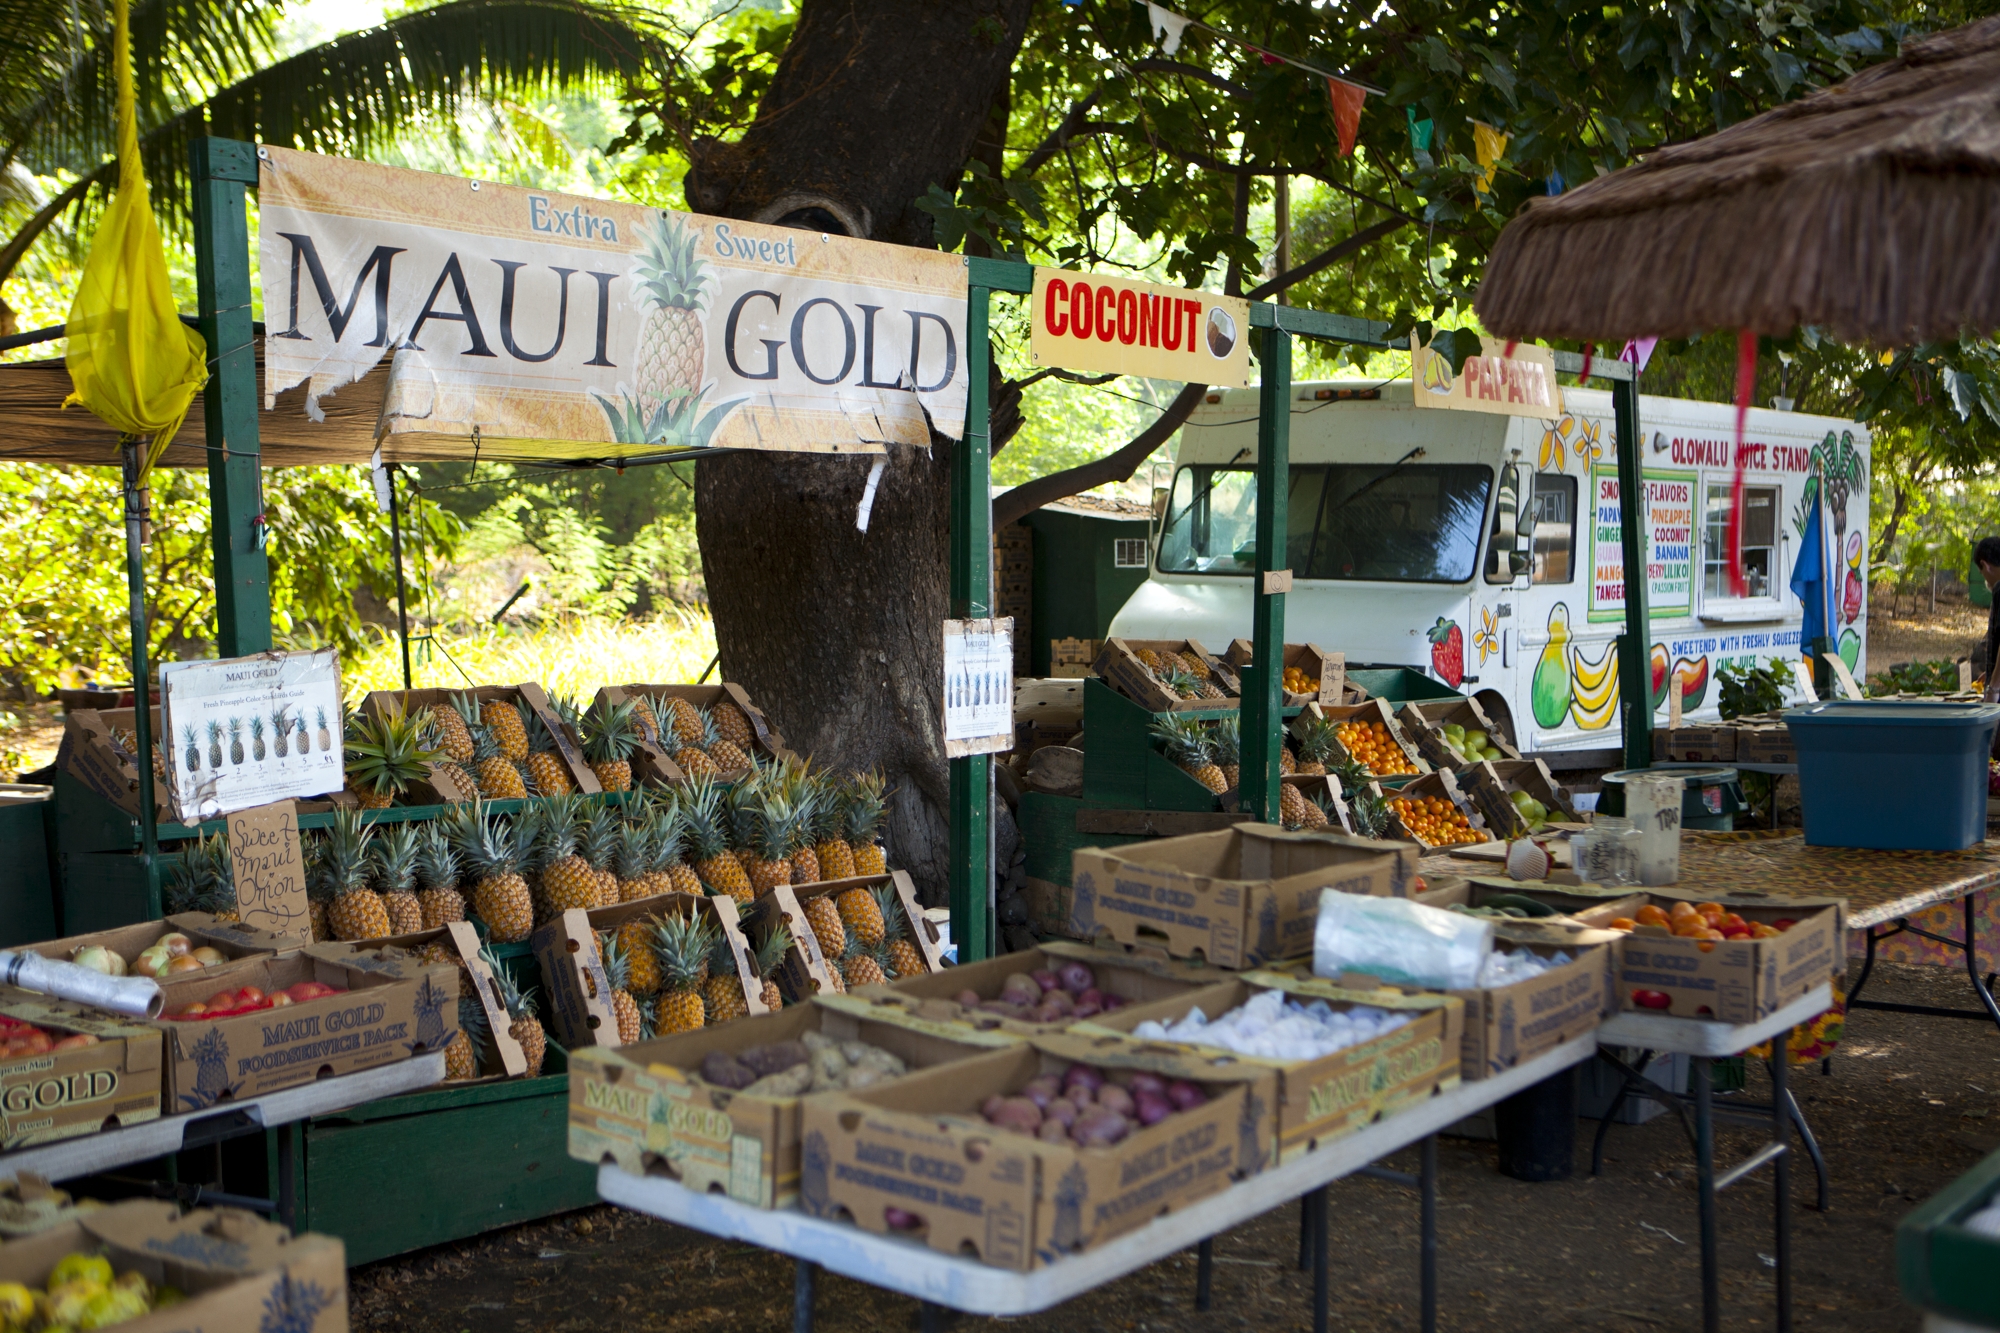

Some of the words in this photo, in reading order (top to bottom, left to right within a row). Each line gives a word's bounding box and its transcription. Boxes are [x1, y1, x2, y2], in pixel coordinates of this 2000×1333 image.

[529, 196, 618, 242] Extra
[714, 225, 796, 266] Sweet
[276, 232, 621, 368] MAUI
[725, 289, 957, 392] GOLD
[1045, 279, 1202, 353] COCONUT
[1464, 355, 1551, 408] PAPAYA
[1672, 437, 1728, 468] OLOWALU
[1772, 446, 1809, 472] STAND
[1650, 483, 1688, 502] FLAVORS
[1544, 494, 1564, 523] EN
[1599, 507, 1621, 523] PAPAY
[1651, 508, 1691, 525] PINEAPPLE
[1655, 527, 1690, 543] COCONUT
[1656, 545, 1689, 561] BANANA
[1596, 584, 1625, 601] TANGER
[1652, 581, 1674, 595] (PASSION
[1672, 638, 1716, 656] SWEETENED
[1720, 636, 1740, 651] WITH
[1742, 633, 1770, 650] FRESHLY
[1716, 655, 1734, 671] CANE
[1739, 654, 1757, 669] JUICE
[226, 670, 250, 683] MAUI
[252, 668, 278, 680] GOLD
[203, 701, 219, 709] Fresh
[219, 696, 245, 707] Pineapple
[245, 694, 261, 703] Color
[289, 689, 305, 698] Guide
[302, 757, 307, 765] 5
[236, 767, 241, 775] 2
[233, 813, 296, 858] Sweet
[240, 873, 304, 911] Onion
[262, 1016, 320, 1047] MAUI
[325, 1003, 384, 1032] GOLD
[238, 1033, 360, 1076] FOODSERVICE
[364, 1022, 408, 1047] PACK
[29, 1059, 53, 1071] Maui
[354, 1055, 375, 1066] Product
[2, 1068, 118, 1115] GOLD
[584, 1079, 649, 1120] MAUI
[668, 1102, 732, 1142] GOLD
[18, 1116, 53, 1132] Sweet
